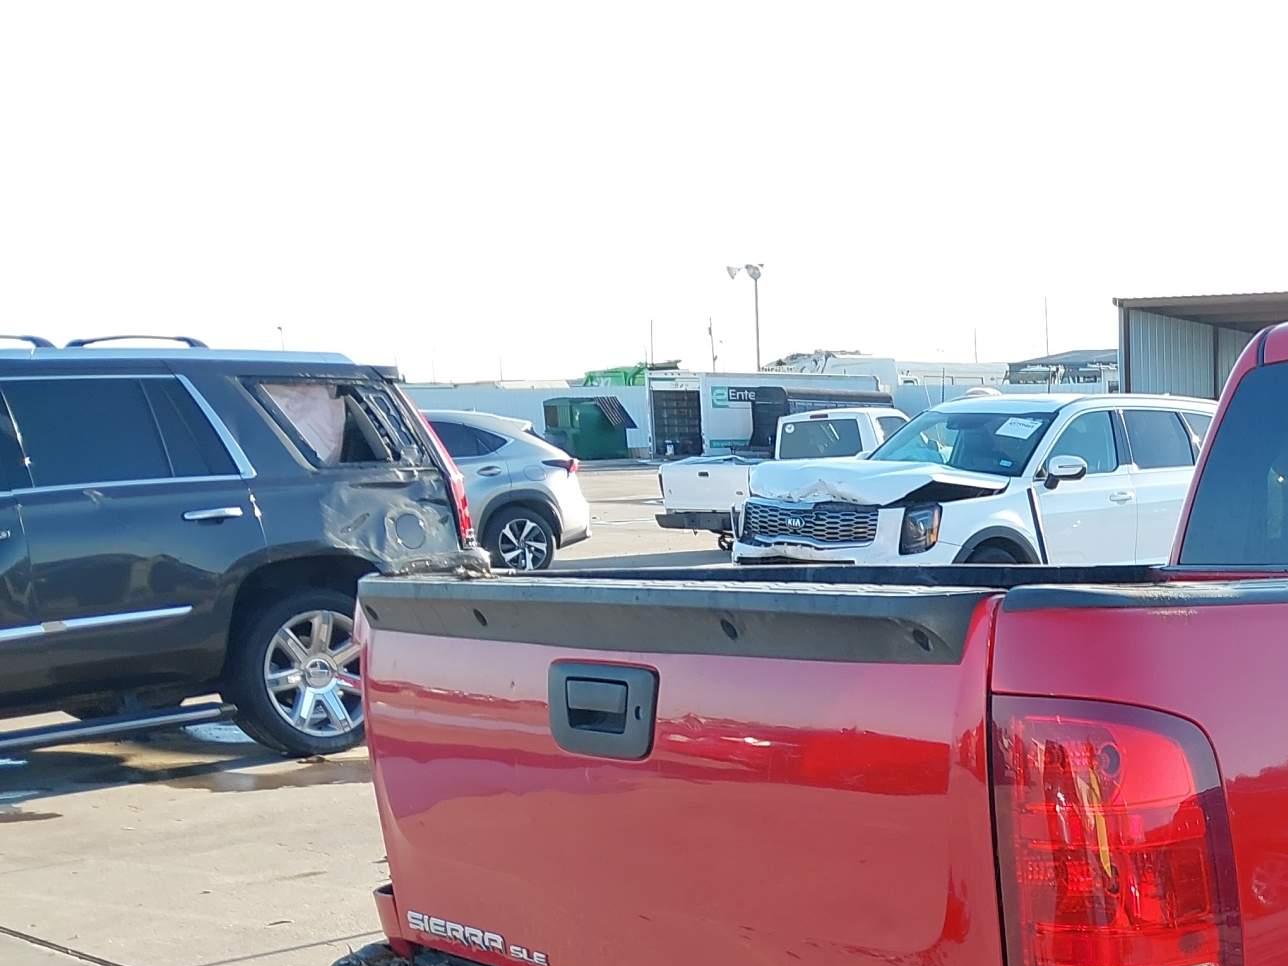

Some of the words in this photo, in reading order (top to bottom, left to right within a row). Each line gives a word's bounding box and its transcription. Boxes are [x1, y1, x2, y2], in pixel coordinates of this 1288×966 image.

[787, 518, 801, 527] KIA
[406, 910, 506, 953] SIERRA
[509, 945, 549, 966] SLE
